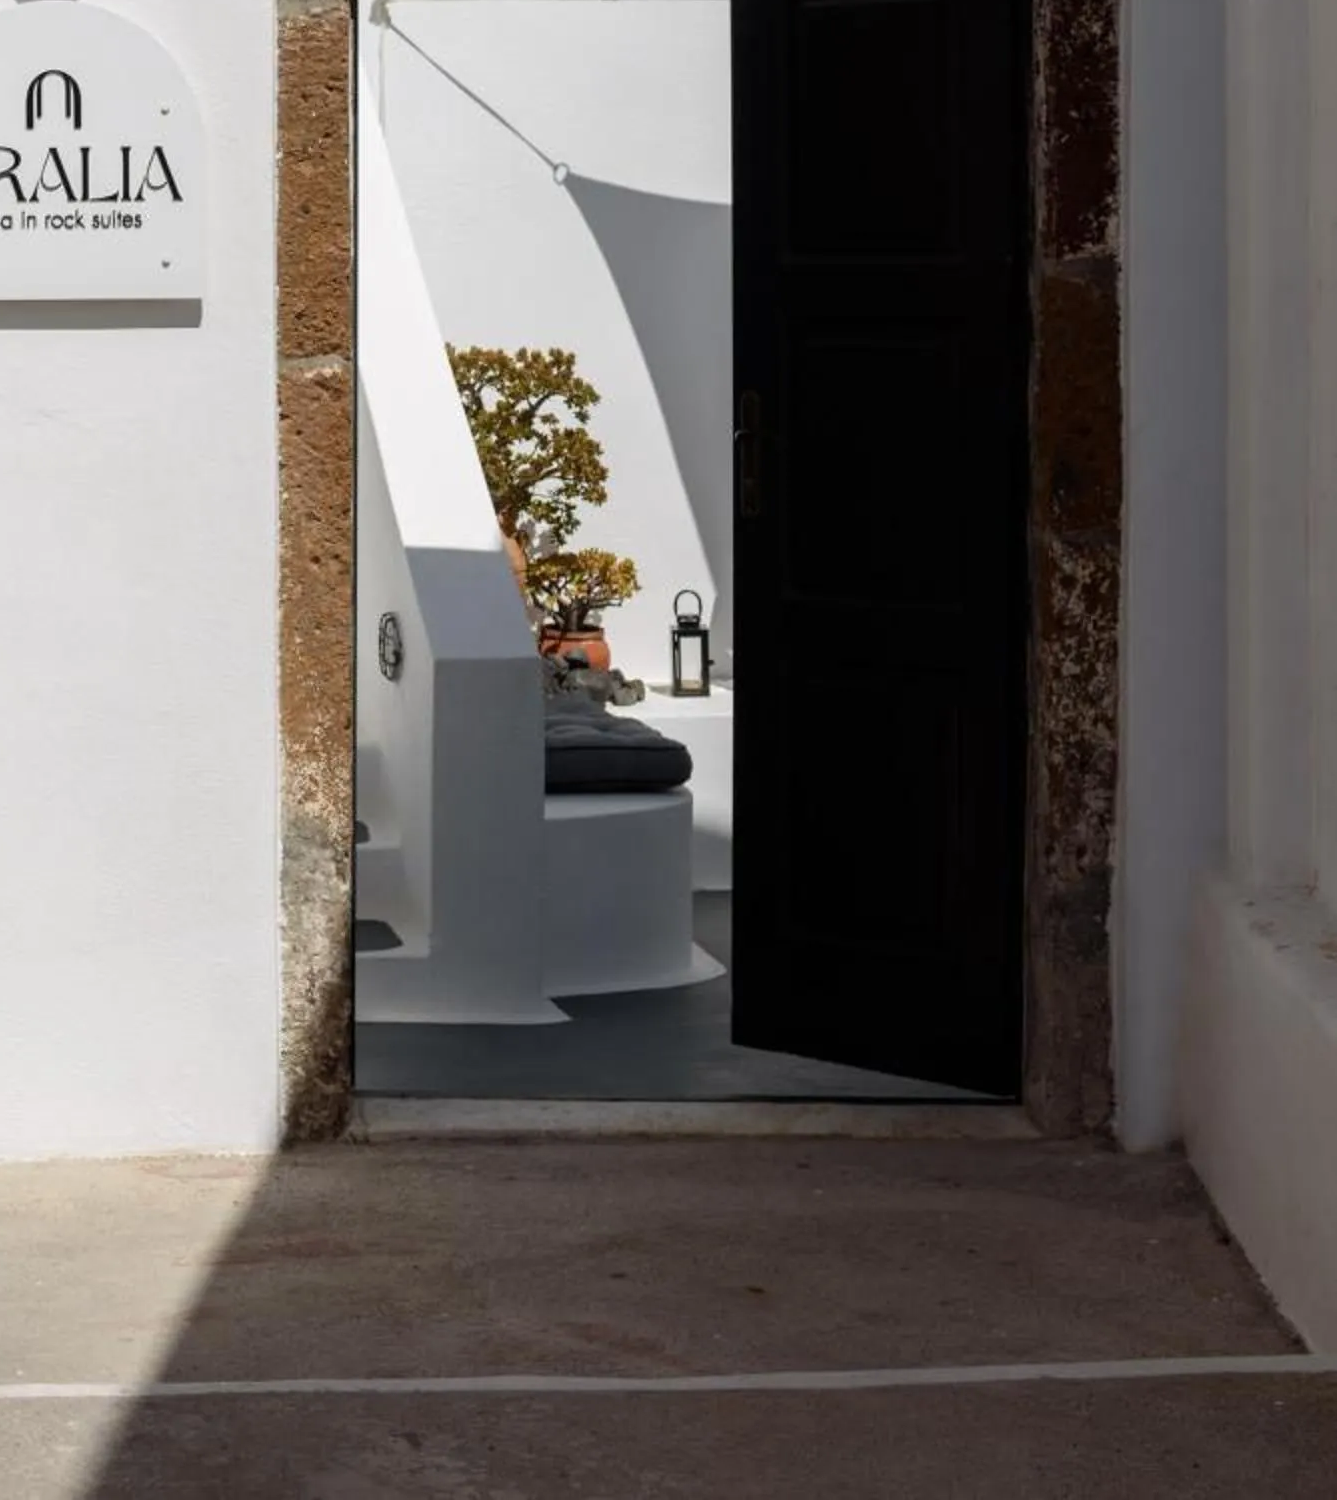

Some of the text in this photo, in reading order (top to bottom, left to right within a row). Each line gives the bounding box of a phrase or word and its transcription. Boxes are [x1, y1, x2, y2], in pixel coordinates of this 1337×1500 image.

[20, 211, 38, 230] in
[44, 209, 86, 230] rock
[91, 210, 143, 230] suites
